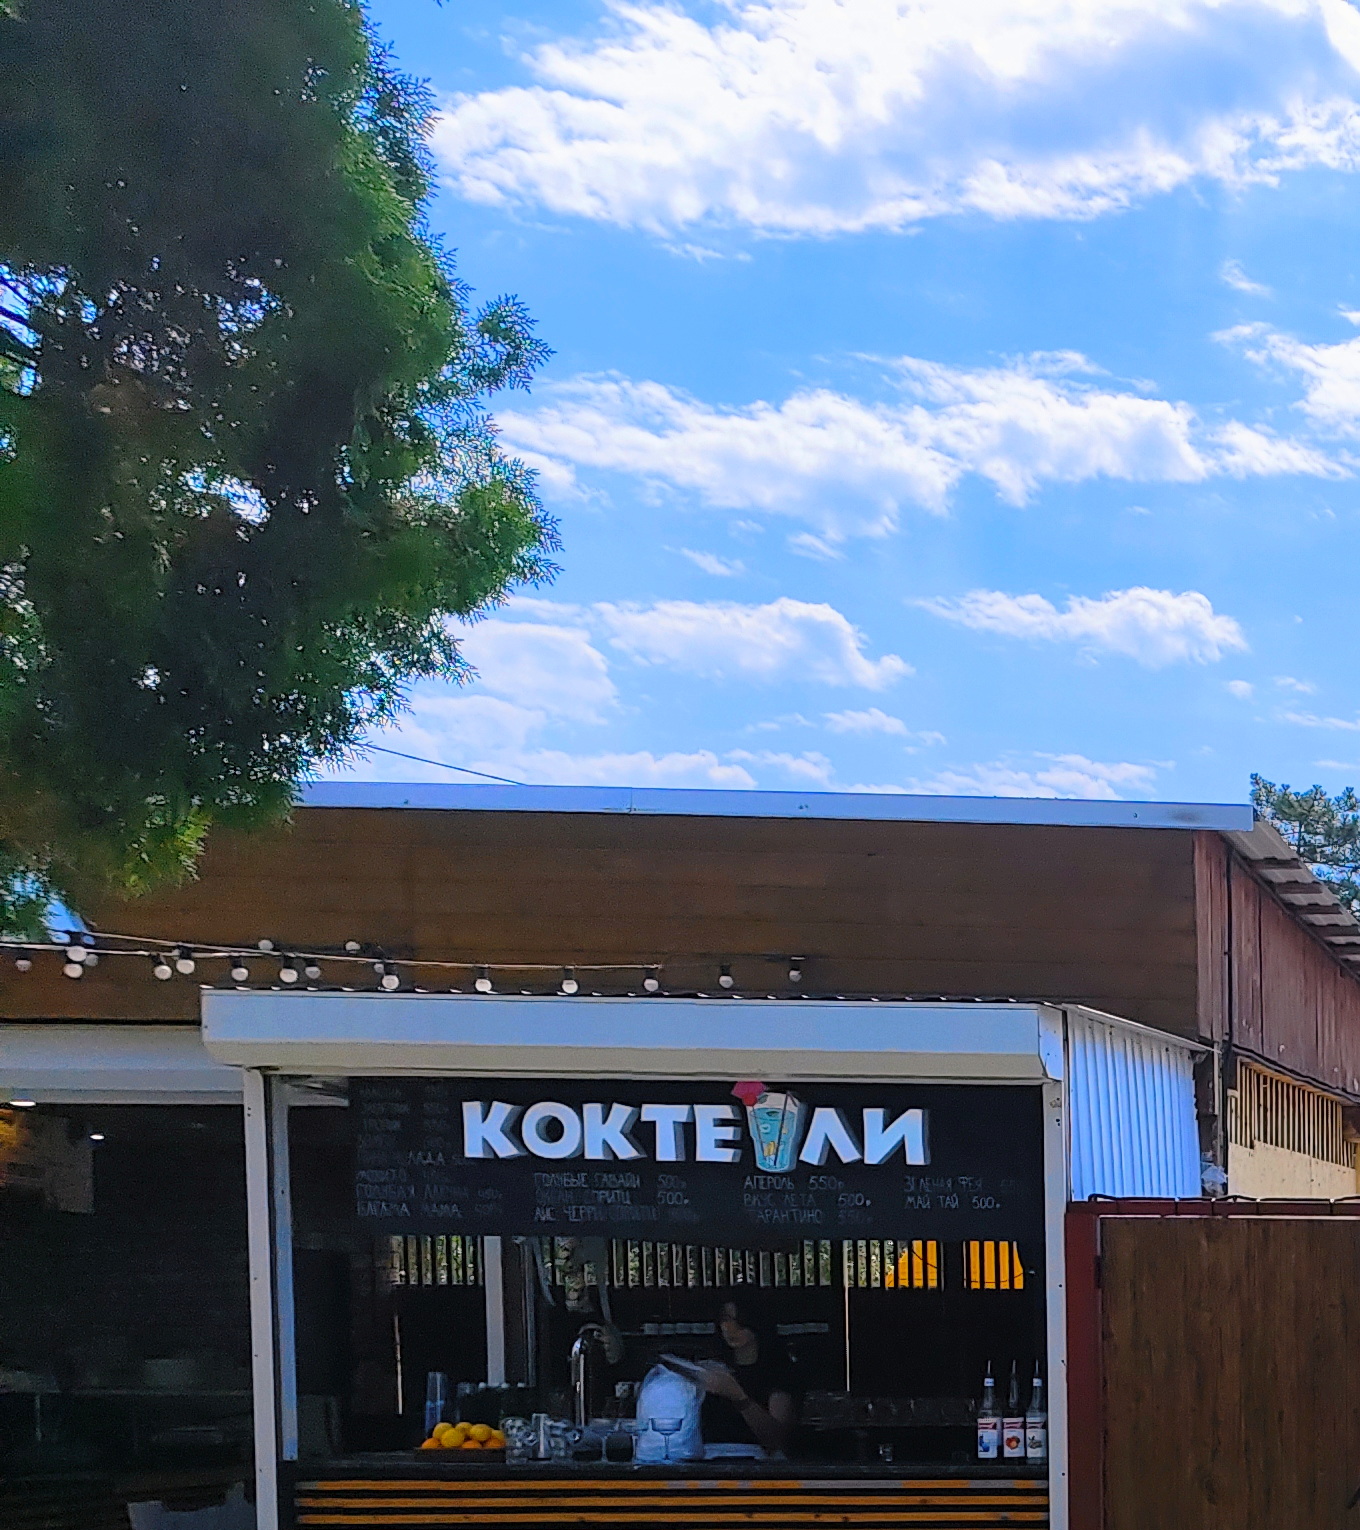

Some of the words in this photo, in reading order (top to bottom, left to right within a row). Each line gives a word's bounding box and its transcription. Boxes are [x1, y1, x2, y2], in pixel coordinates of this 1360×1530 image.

[462, 1100, 930, 1166] КОКТЕЛИ
[743, 1175, 795, 1191] АПЕРОЛЬ
[904, 1194, 931, 1210] МАЙ
[936, 1192, 960, 1210] ТАЙ
